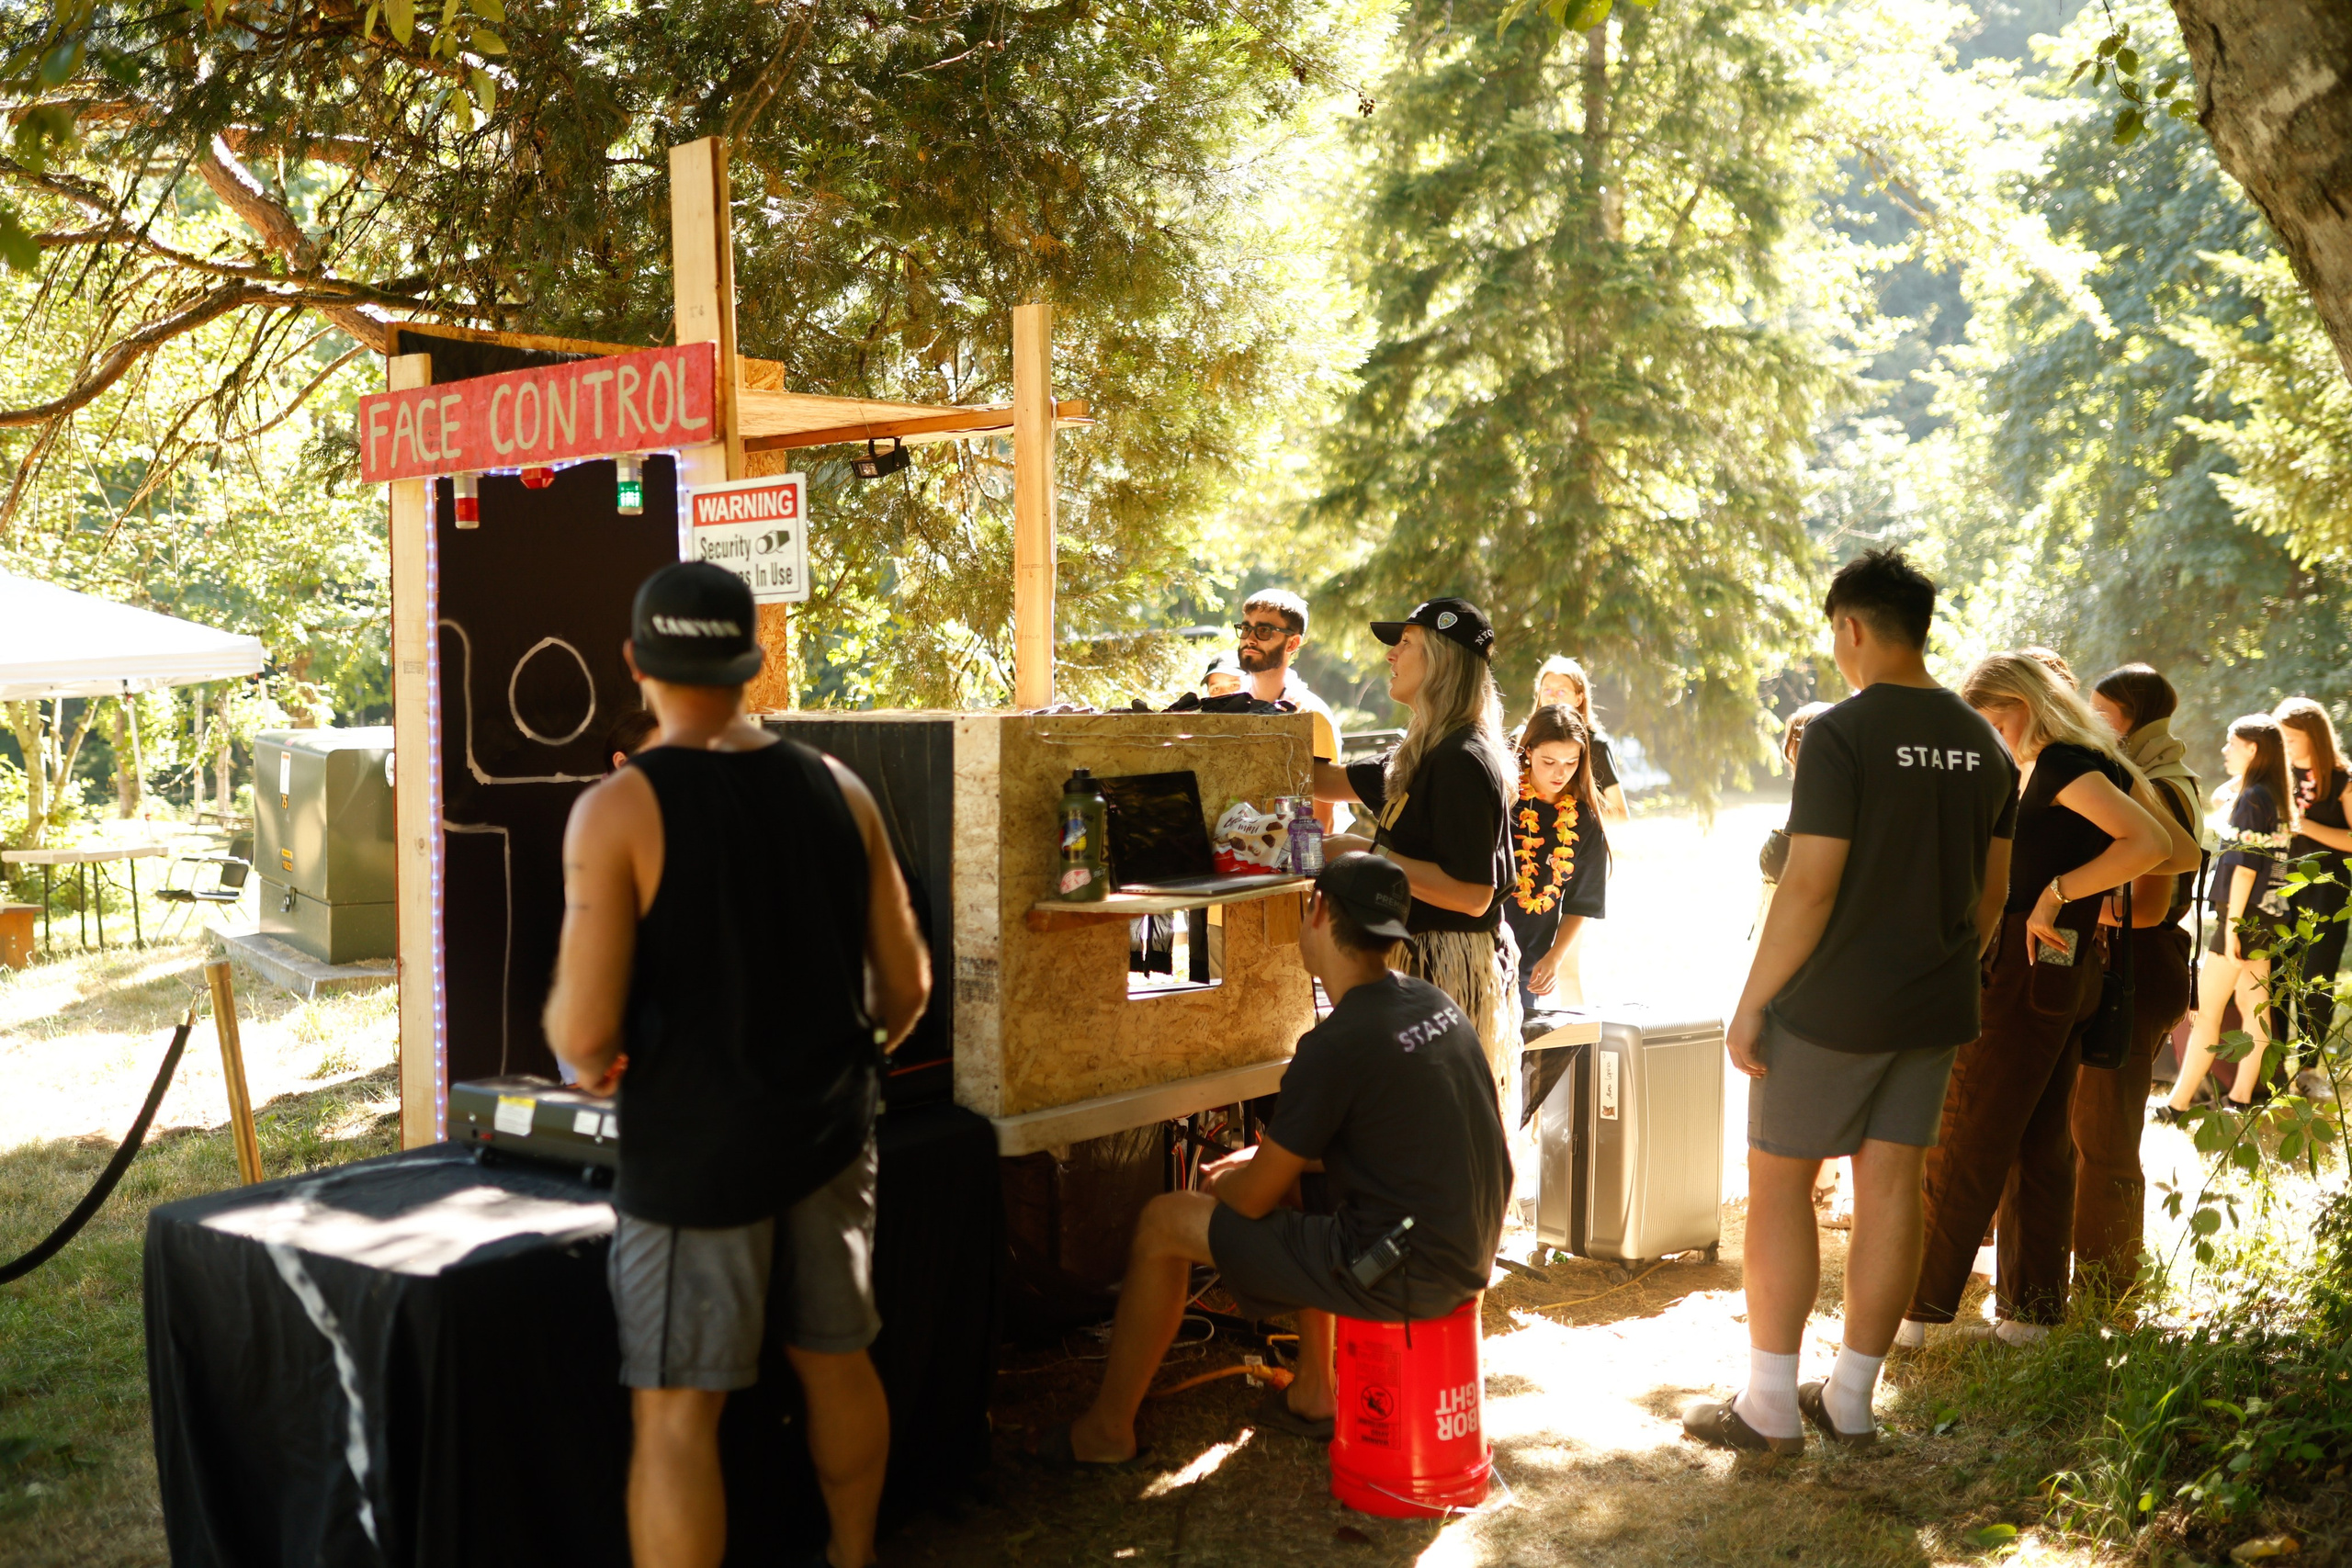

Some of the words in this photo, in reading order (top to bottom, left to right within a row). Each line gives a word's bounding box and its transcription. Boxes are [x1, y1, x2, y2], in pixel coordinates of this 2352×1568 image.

[369, 394, 463, 473] FACE
[489, 356, 708, 455] CONTROL
[697, 489, 794, 524] WARNING
[700, 534, 752, 562] Security
[755, 563, 767, 587] In
[770, 562, 793, 586] Use
[1896, 746, 1981, 772] STAFF
[1398, 1007, 1459, 1054] STAFF
